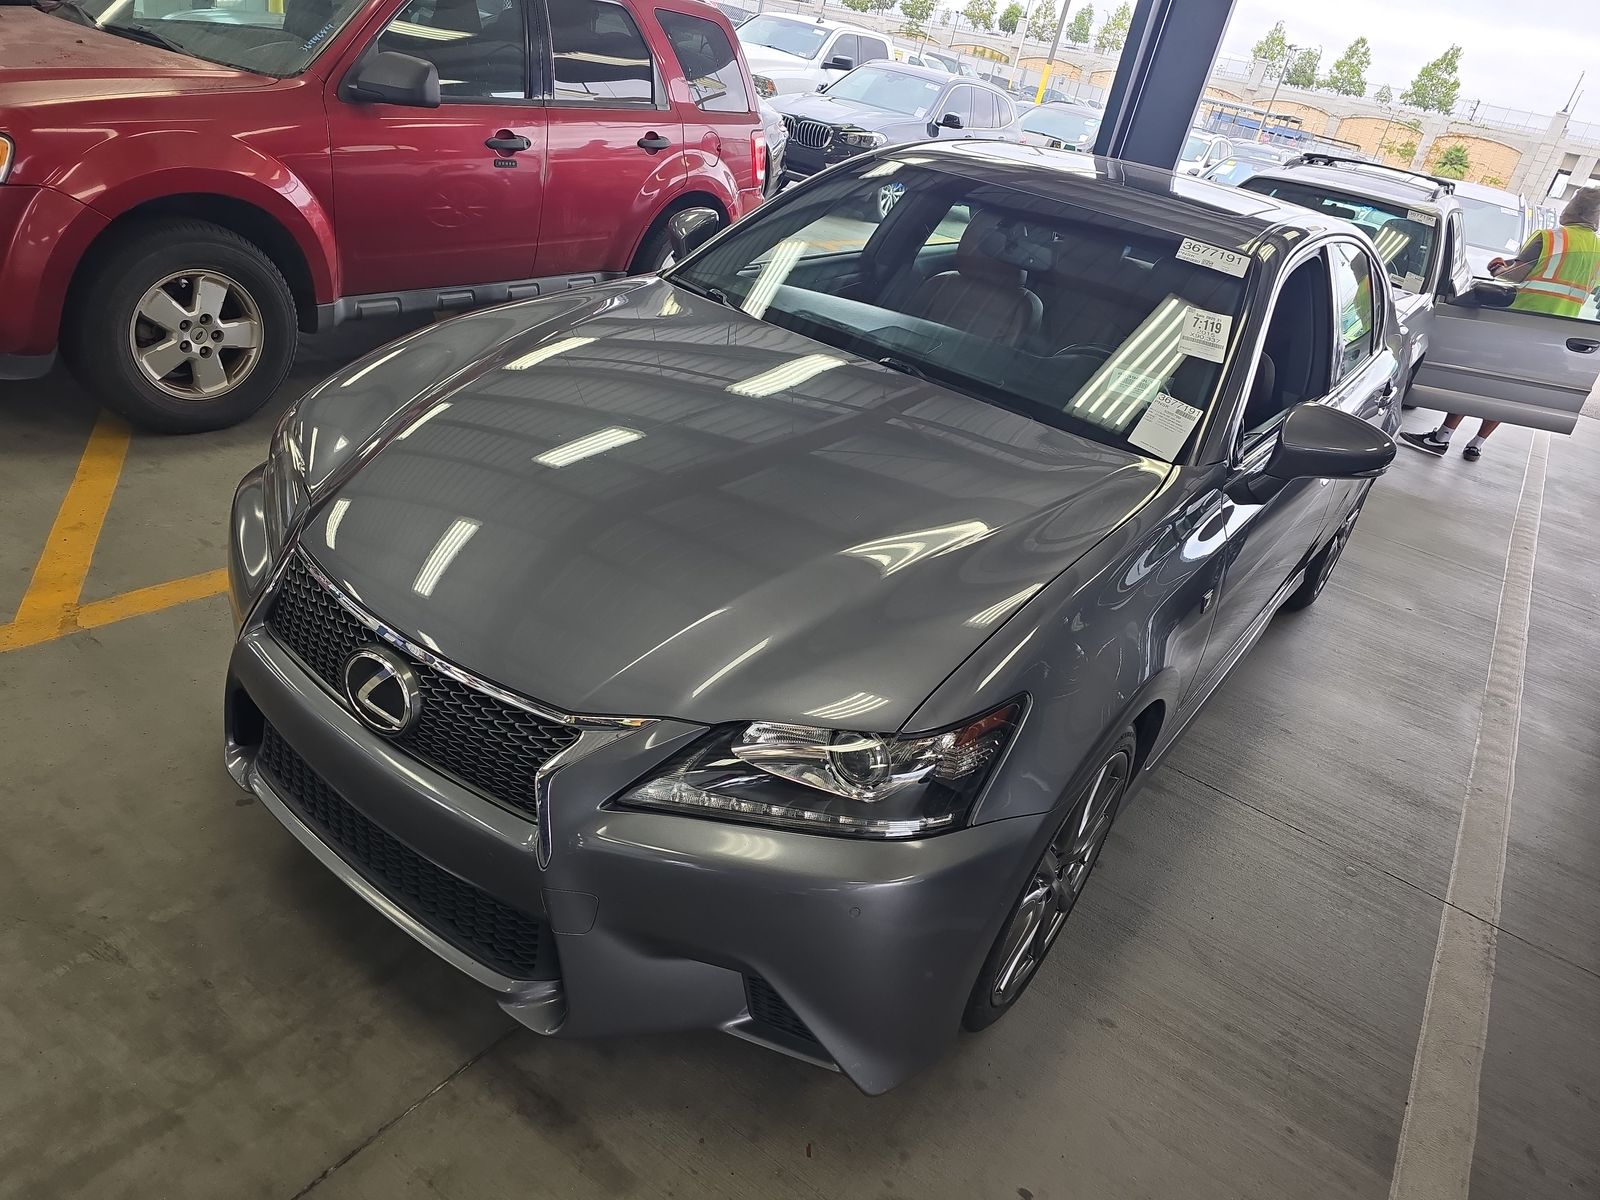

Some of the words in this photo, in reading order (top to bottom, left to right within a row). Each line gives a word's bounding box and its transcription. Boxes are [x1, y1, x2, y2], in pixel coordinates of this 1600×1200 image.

[1183, 241, 1243, 265] 3677191
[1193, 316, 1222, 334] 7:119
[1158, 394, 1201, 416] 3677191
